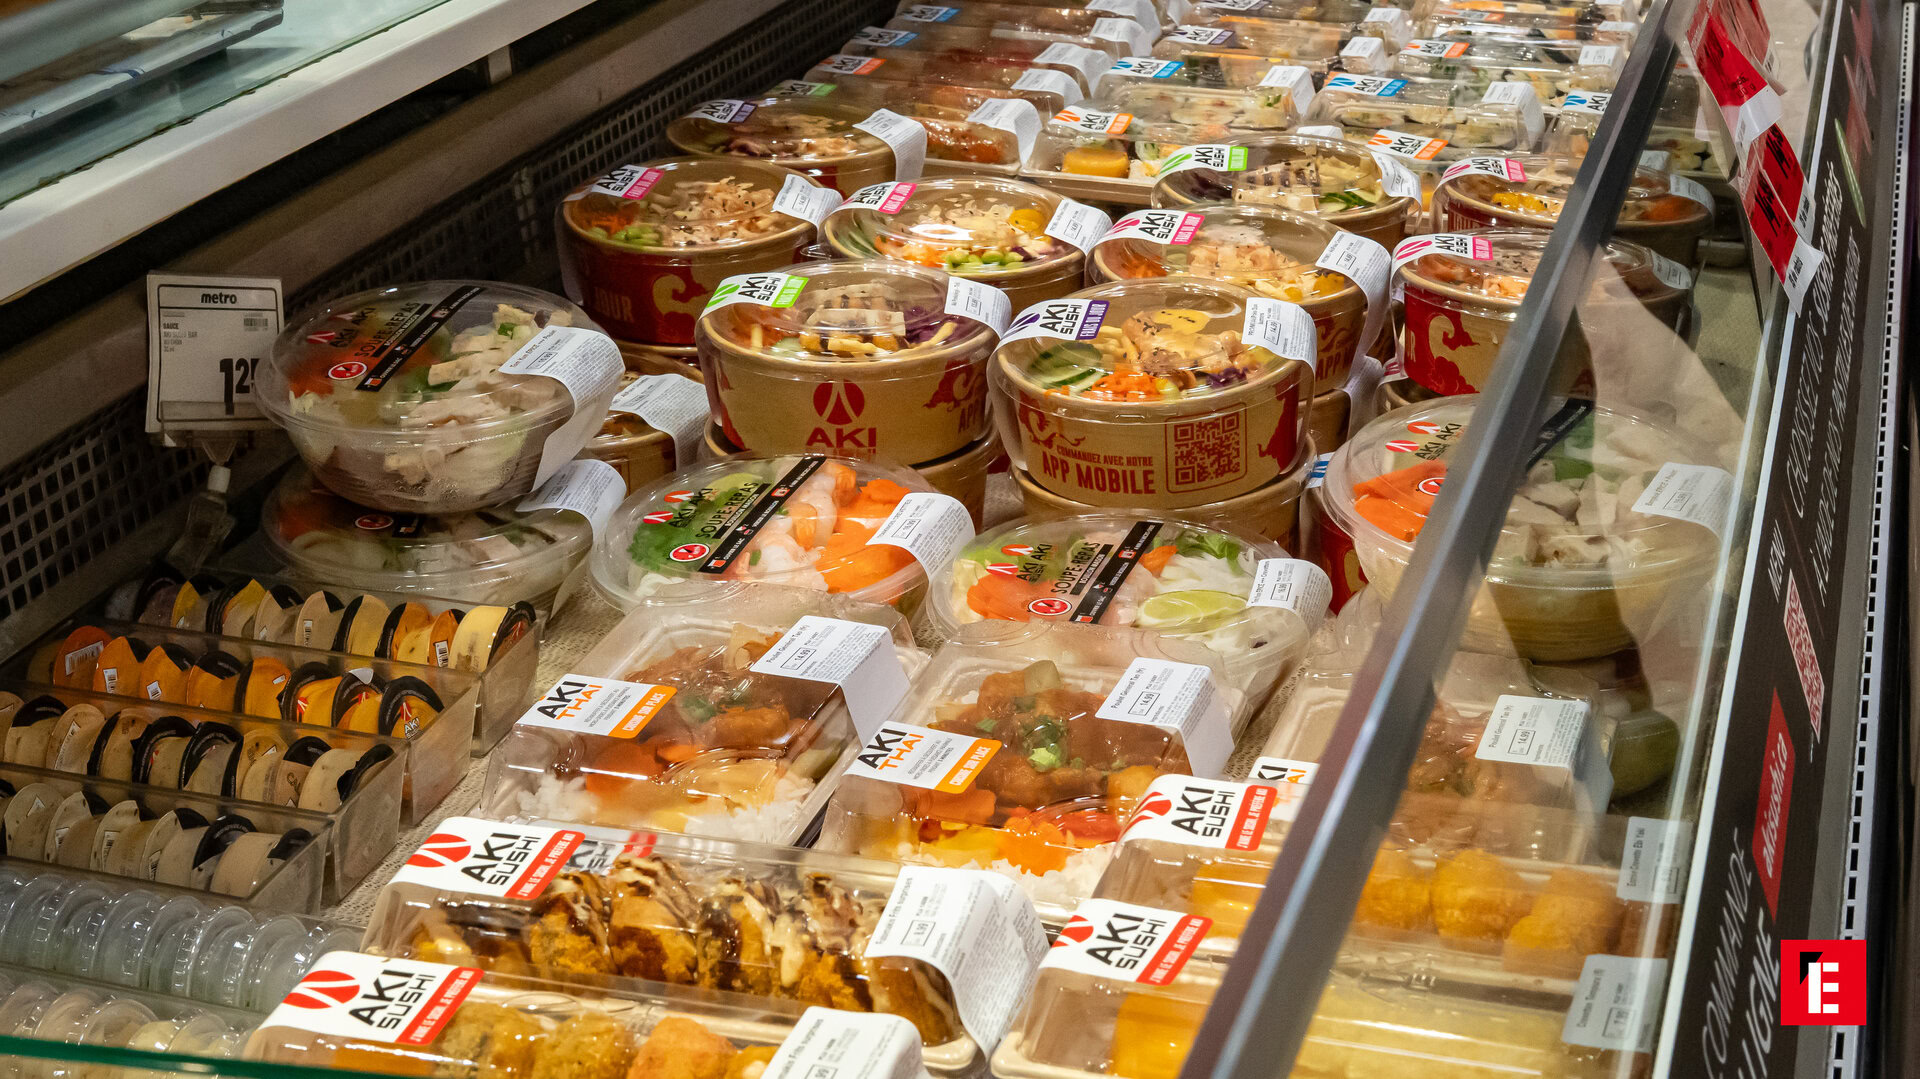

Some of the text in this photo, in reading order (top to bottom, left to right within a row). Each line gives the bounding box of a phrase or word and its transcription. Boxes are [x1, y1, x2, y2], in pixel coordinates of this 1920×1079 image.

[1080, 113, 1102, 130] AKI
[1194, 146, 1214, 166] AKI
[1390, 136, 1416, 153] AKI
[596, 168, 627, 190] AKI
[1138, 212, 1168, 236] AKI
[1434, 235, 1456, 252] AKI
[201, 292, 238, 304] metro
[738, 276, 769, 299] AKI
[162, 322, 179, 330] SAUCE
[1039, 304, 1069, 333] AKI
[1060, 304, 1083, 335] SUSHI
[1804, 306, 1823, 385] VOS
[806, 426, 876, 448] AKI
[1436, 422, 1462, 440] AKI
[1056, 444, 1153, 467] COMMANDEZ AVEC NOTRE
[1415, 442, 1442, 460] AKI
[1042, 450, 1156, 495] APP MOBILE
[668, 508, 691, 528] AKI
[696, 482, 759, 538] SOUPE-REPAS
[1035, 543, 1054, 562] AKI
[1768, 519, 1786, 604] MENU
[1016, 562, 1038, 582] AKI
[1050, 542, 1101, 594] SOUPE-REPAS
[536, 680, 589, 720] AKI
[556, 684, 604, 720] THAI
[404, 717, 420, 734] AKI
[856, 728, 908, 770] AKI
[878, 733, 924, 770] THAI
[1257, 765, 1288, 780] KI
[1170, 786, 1215, 835] AKI
[1202, 790, 1236, 838] SUSHI
[1763, 732, 1788, 879] akisushi.ca
[460, 832, 522, 882] AKI
[486, 835, 542, 886] SUSHI
[1085, 912, 1145, 966] AKI
[1114, 919, 1168, 970] SUSHI
[348, 969, 415, 1026] AKI
[376, 974, 437, 1030] SUSHI
